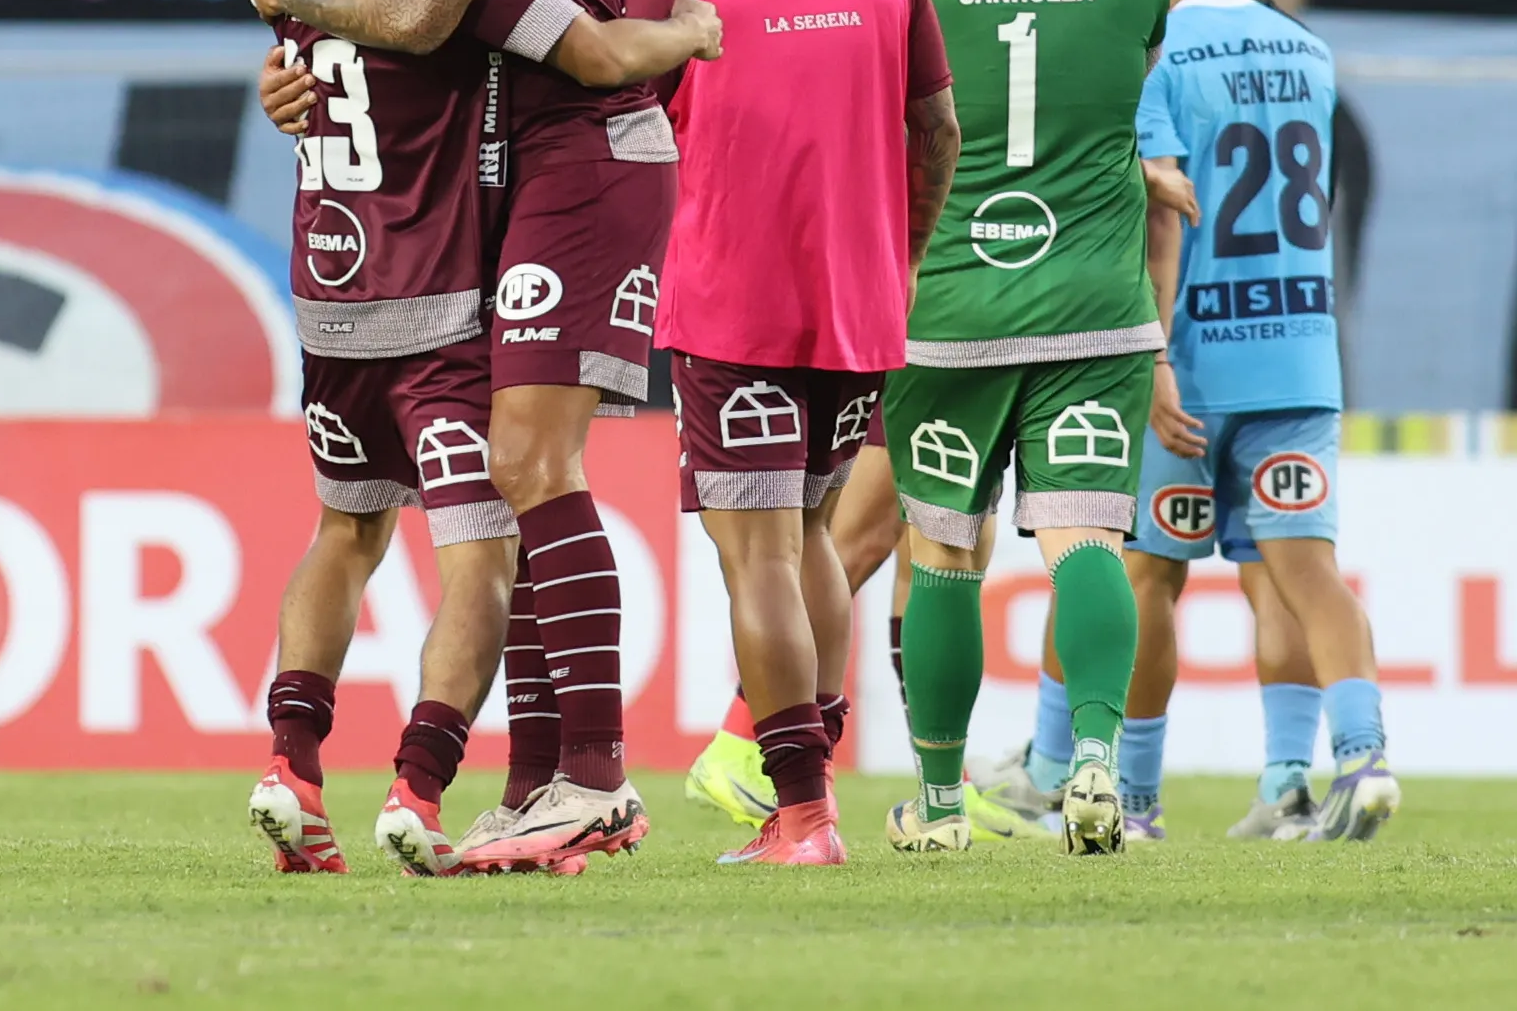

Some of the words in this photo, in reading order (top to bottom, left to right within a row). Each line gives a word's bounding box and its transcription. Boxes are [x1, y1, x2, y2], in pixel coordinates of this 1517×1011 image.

[764, 17, 791, 33] LA
[794, 11, 863, 31] SERENA
[484, 51, 502, 133] Mining
[997, 12, 1037, 167] 1
[1221, 69, 1312, 105] VENEZIA
[1214, 120, 1329, 259] 28
[970, 221, 1050, 240] EBEMA
[504, 273, 543, 309] PF
[319, 322, 354, 333] FIUME
[501, 327, 561, 345] FIUME
[1272, 464, 1311, 500] PF
[1170, 496, 1211, 531] PF
